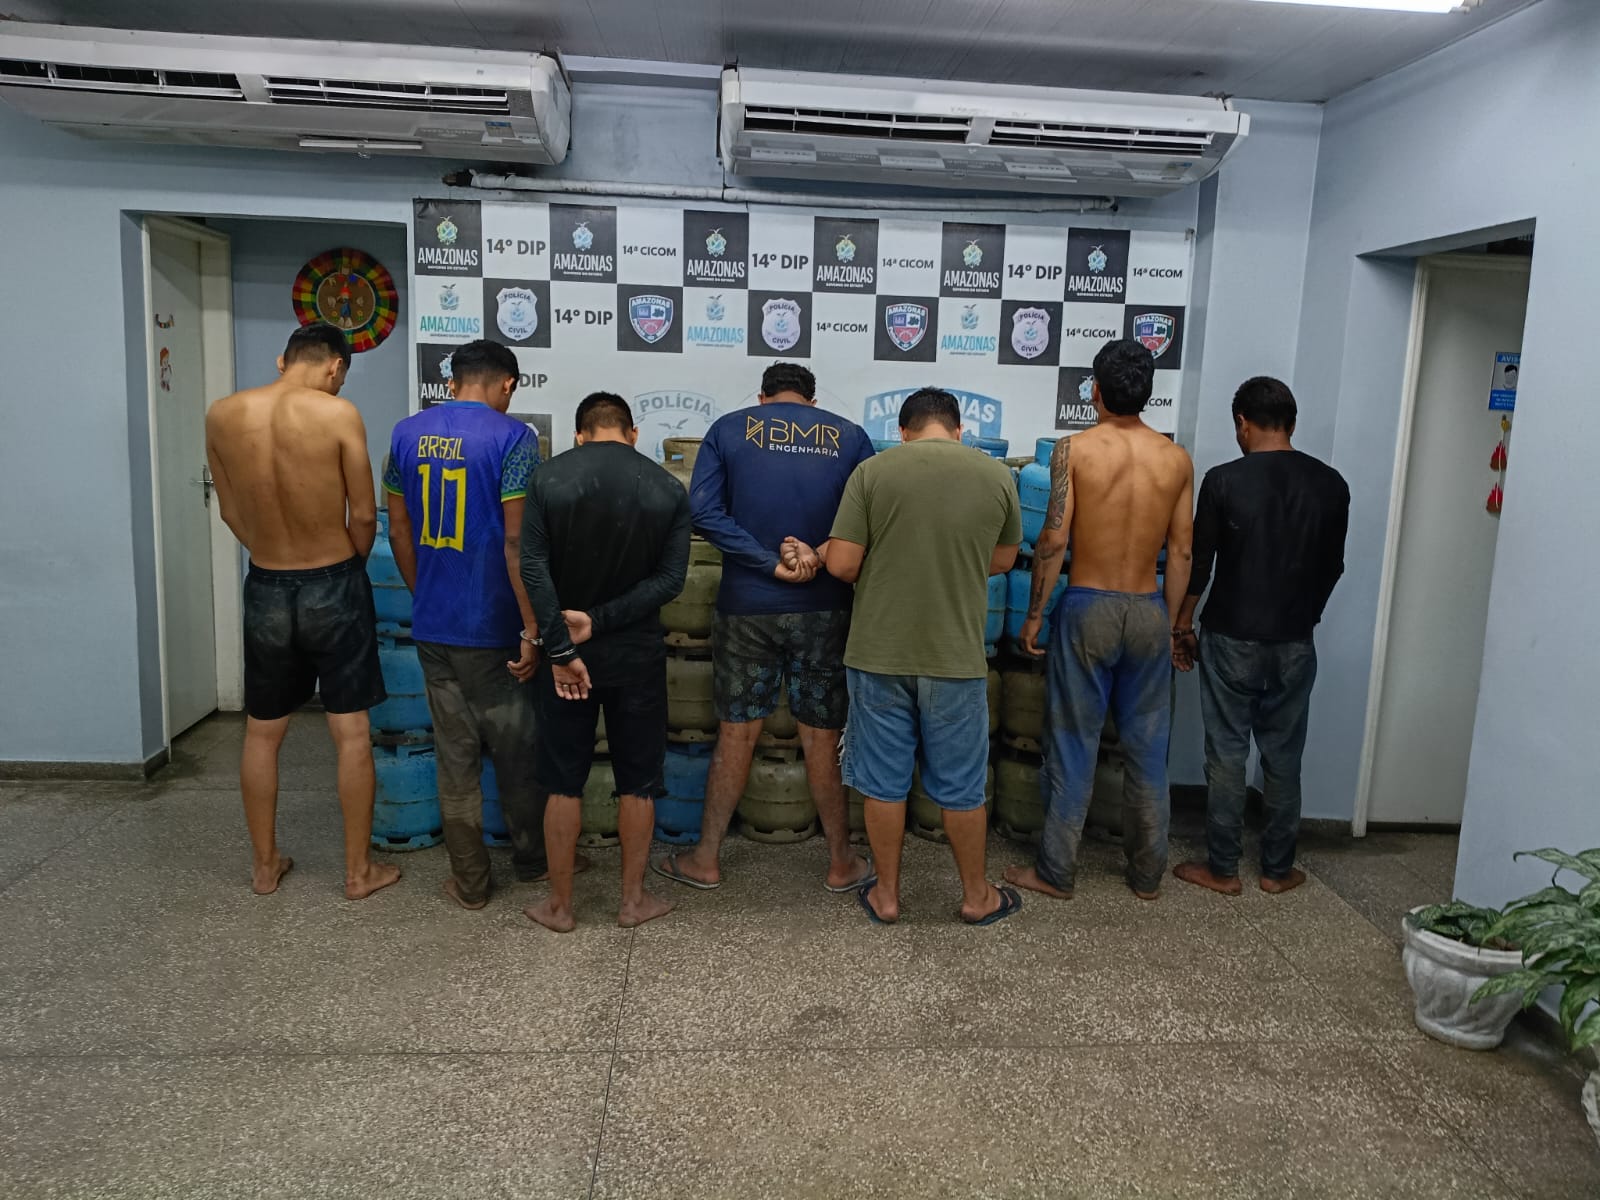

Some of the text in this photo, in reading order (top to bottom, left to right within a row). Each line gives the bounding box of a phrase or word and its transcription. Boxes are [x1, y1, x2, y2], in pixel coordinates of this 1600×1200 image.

[517, 240, 546, 256] DIP
[640, 246, 677, 257] CICOM
[418, 248, 478, 266] AMAZONAS
[553, 253, 613, 272] AMAZONAS
[781, 255, 809, 270] DIP
[899, 258, 934, 269] CICOM
[687, 259, 745, 278] AMAZONAS
[816, 265, 874, 283] AMAZONAS
[1035, 265, 1062, 280] DIP
[1149, 268, 1183, 278] CICOM
[943, 270, 1000, 288] AMAZONAS
[1068, 275, 1124, 293] AMAZONAS
[631, 297, 671, 308] AMAZONAS
[888, 304, 926, 316] AMAZONAS
[420, 316, 480, 334] AMAZONAS
[585, 310, 613, 325] DIP
[1136, 315, 1173, 326] AMAZONAS
[687, 325, 744, 344] AMAZONAS
[833, 322, 868, 333] CICOM
[1082, 328, 1116, 338] CICOM
[940, 335, 996, 352] AMAZONAS
[519, 373, 548, 388] DIP
[421, 383, 455, 399] AMAZ
[639, 393, 712, 416] POLÍCIA
[770, 417, 840, 449] BMR
[417, 435, 465, 461] BRASIL
[769, 443, 839, 458] ENGENHARIA
[417, 463, 467, 552] 10
